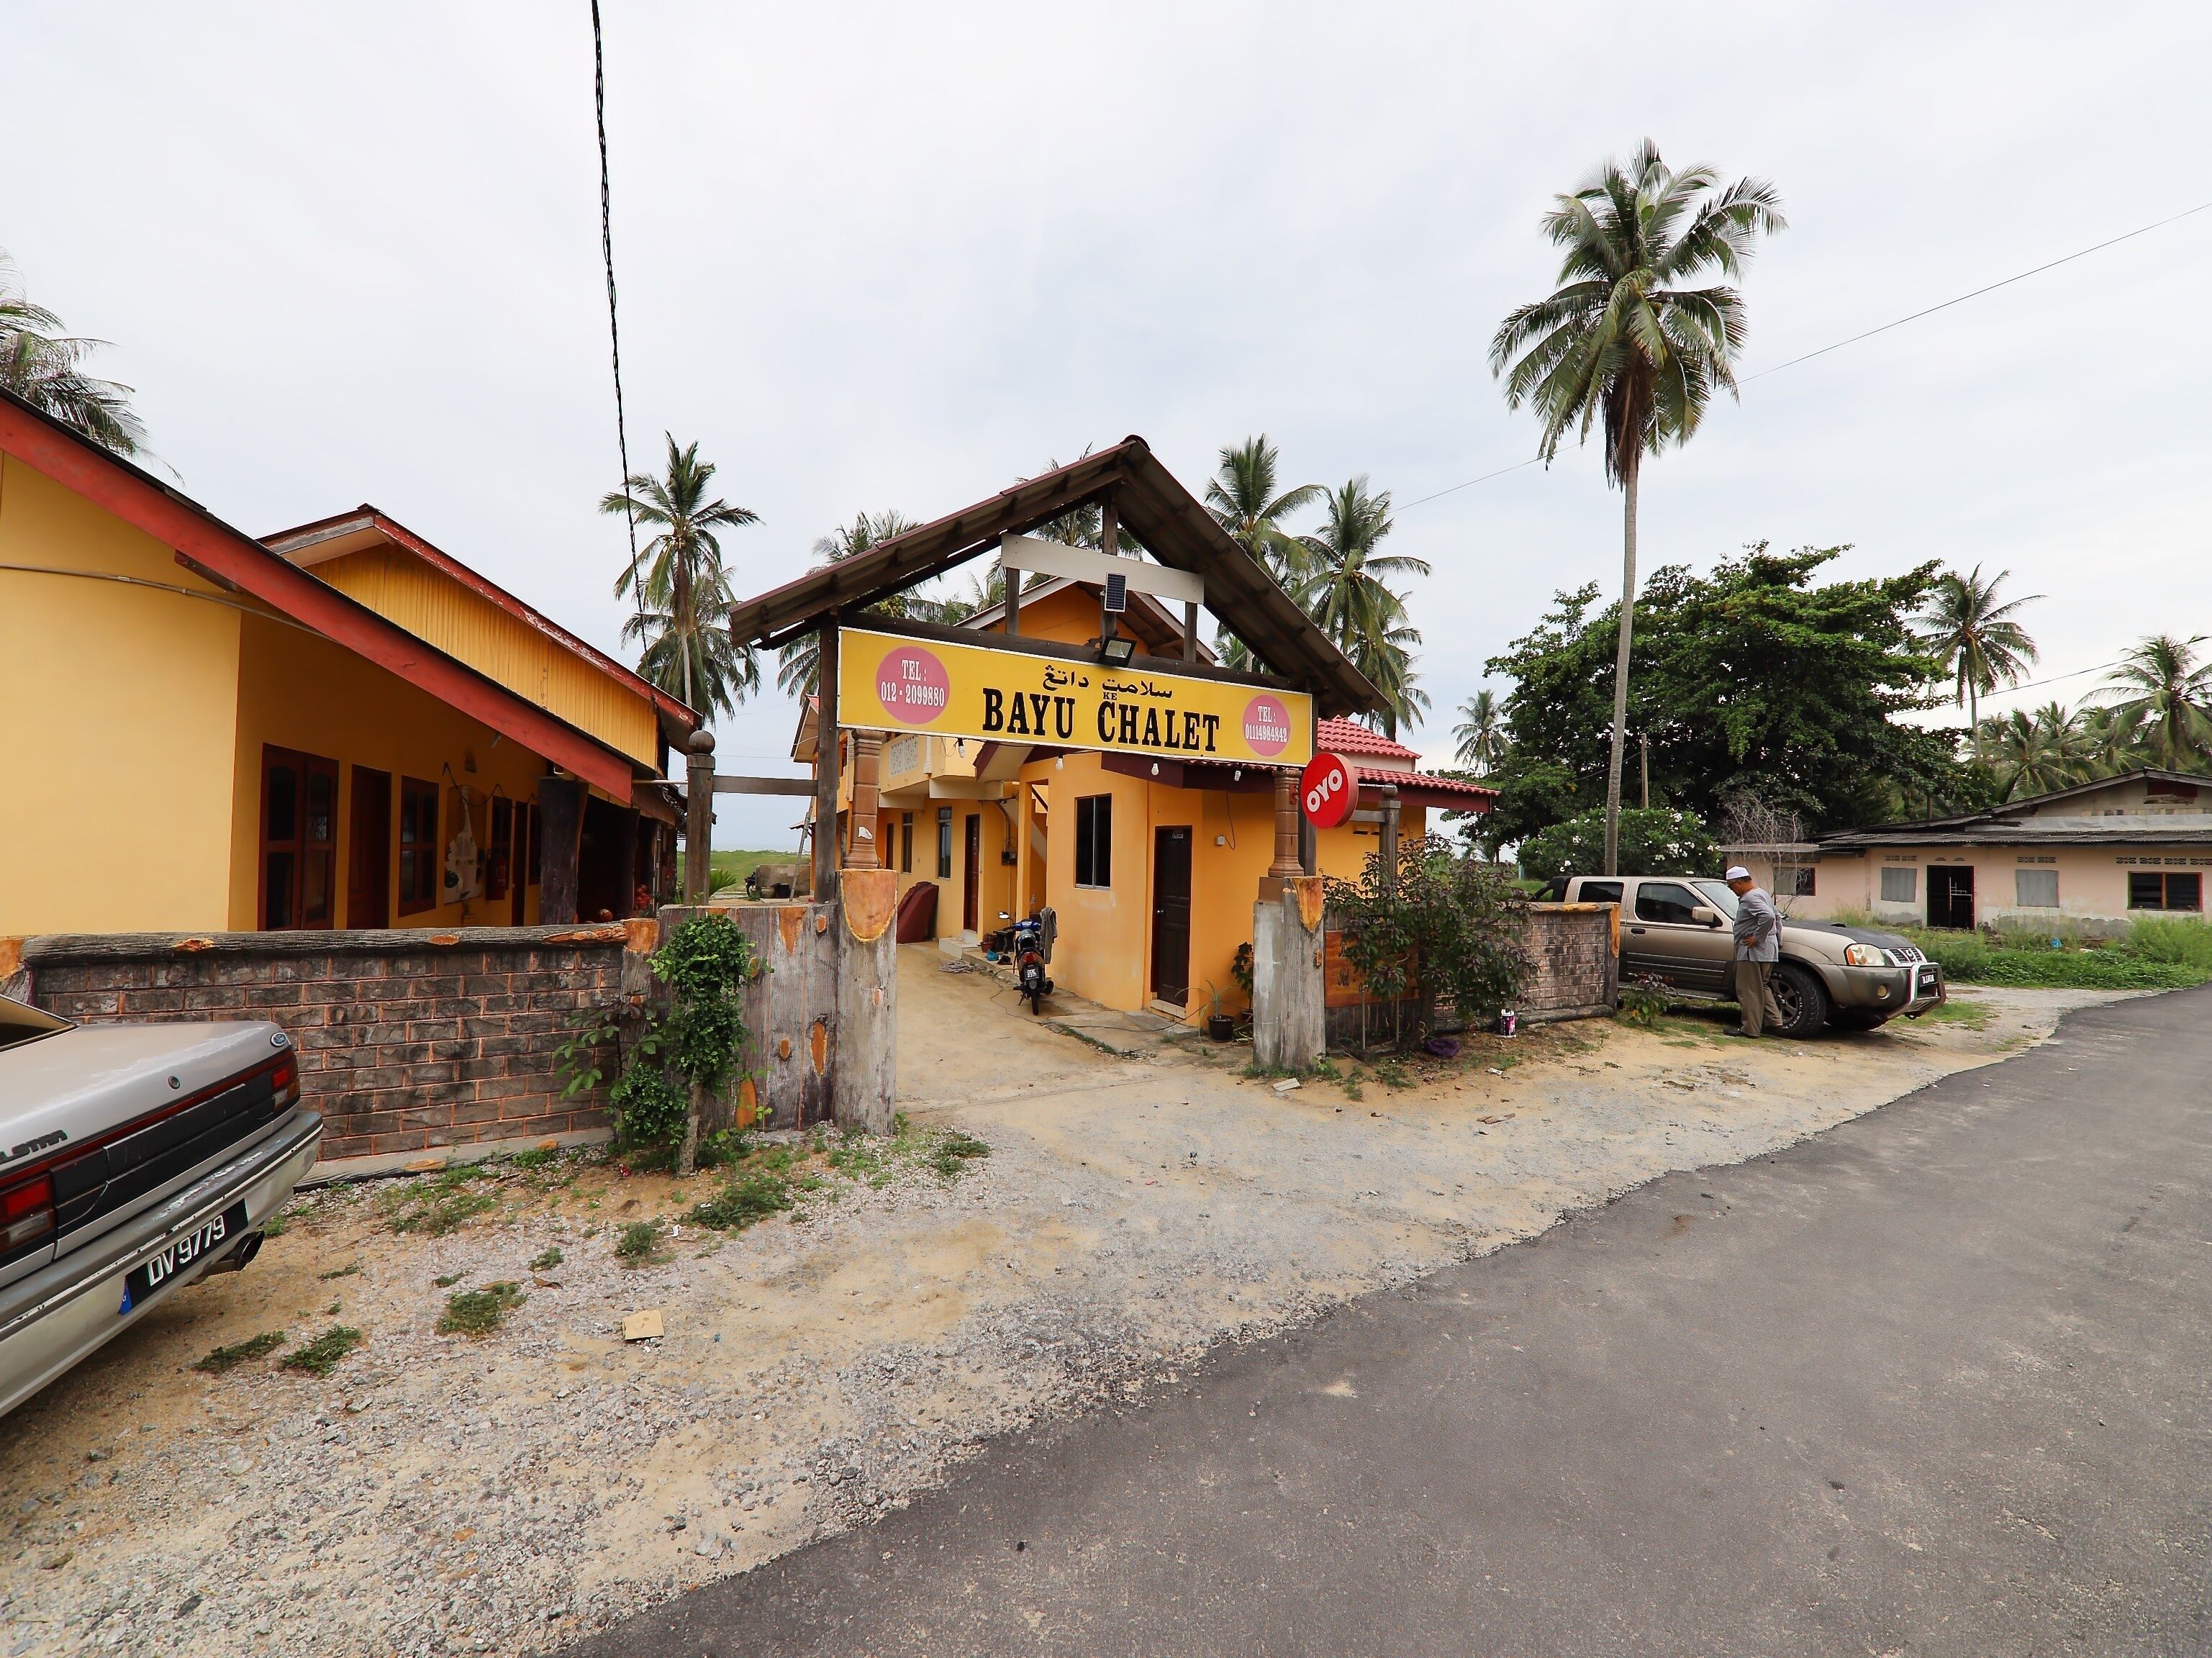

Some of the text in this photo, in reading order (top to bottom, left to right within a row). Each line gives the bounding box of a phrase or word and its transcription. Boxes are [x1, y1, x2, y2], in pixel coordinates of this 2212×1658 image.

[1102, 679, 1173, 699] سلامت
[1102, 692, 1118, 701] KE
[982, 687, 1220, 753] BAYU CHALET
[1307, 769, 1343, 812] OYO
[147, 1215, 226, 1287] DV 9779
